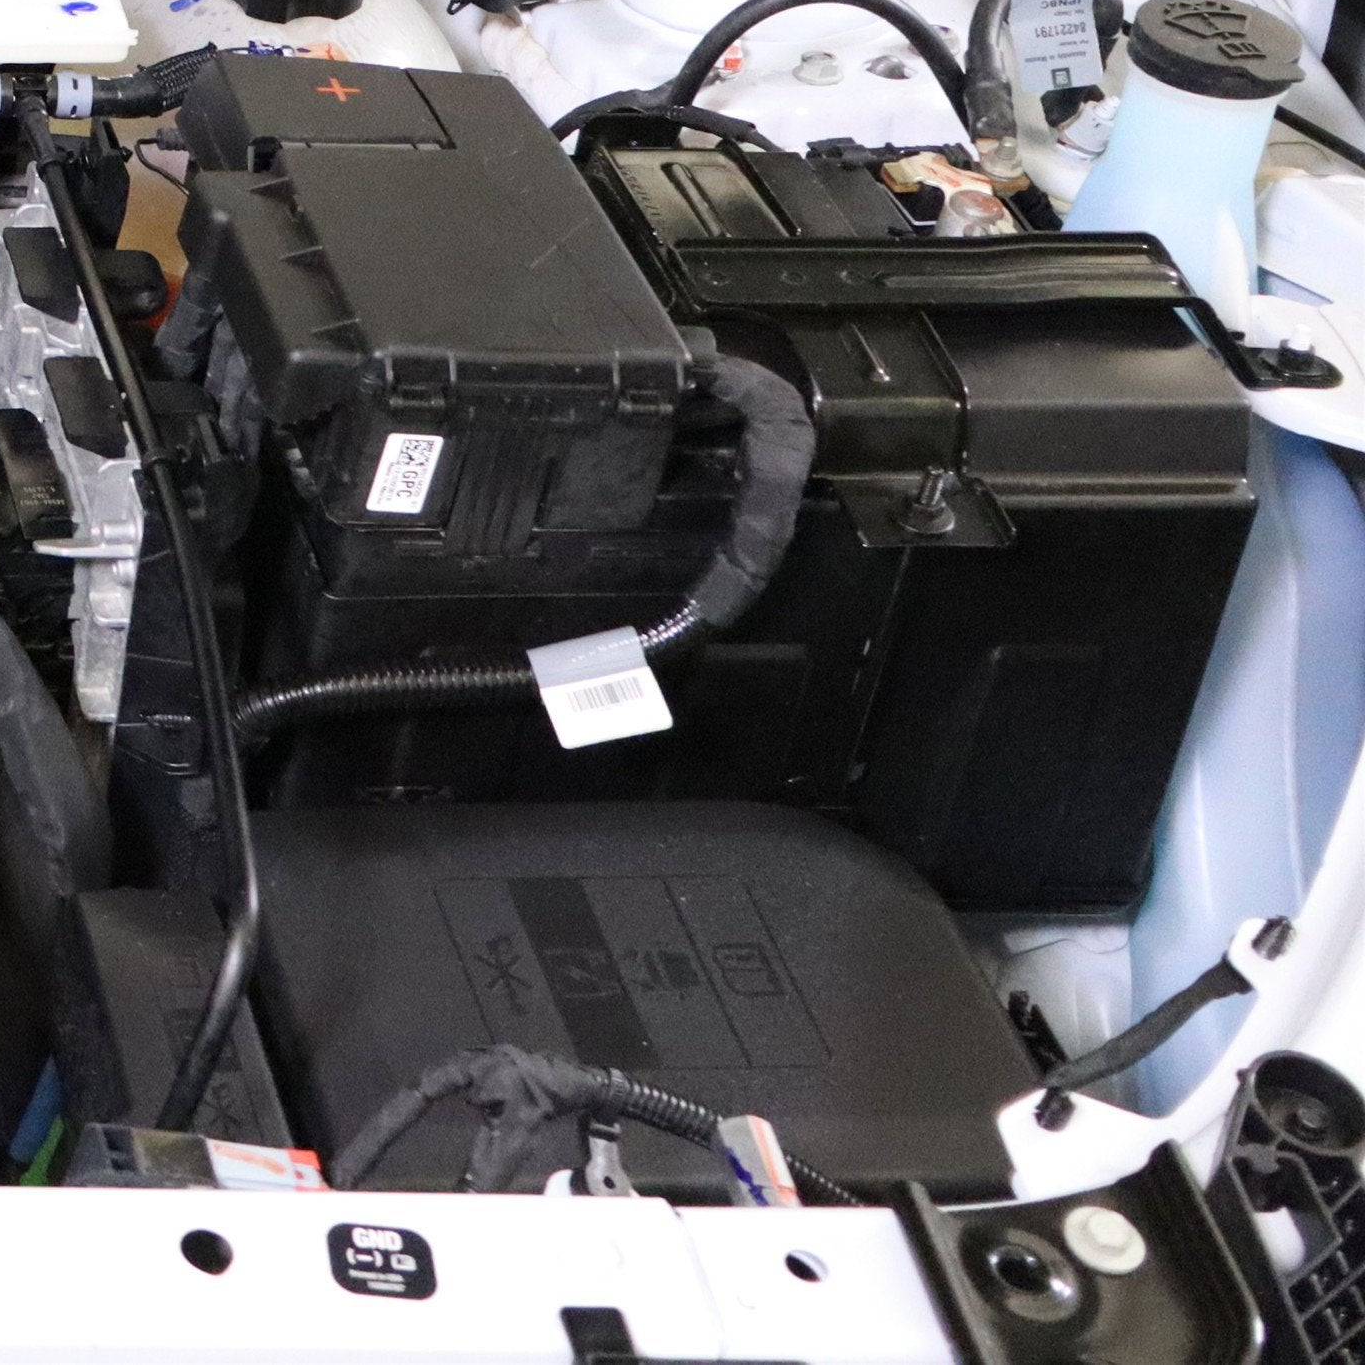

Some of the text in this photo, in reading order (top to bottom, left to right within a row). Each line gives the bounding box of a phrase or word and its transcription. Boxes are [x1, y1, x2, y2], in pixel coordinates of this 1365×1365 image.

[1034, 21, 1087, 39] 84221791
[397, 471, 418, 497] GPC
[352, 1227, 404, 1252] GND
